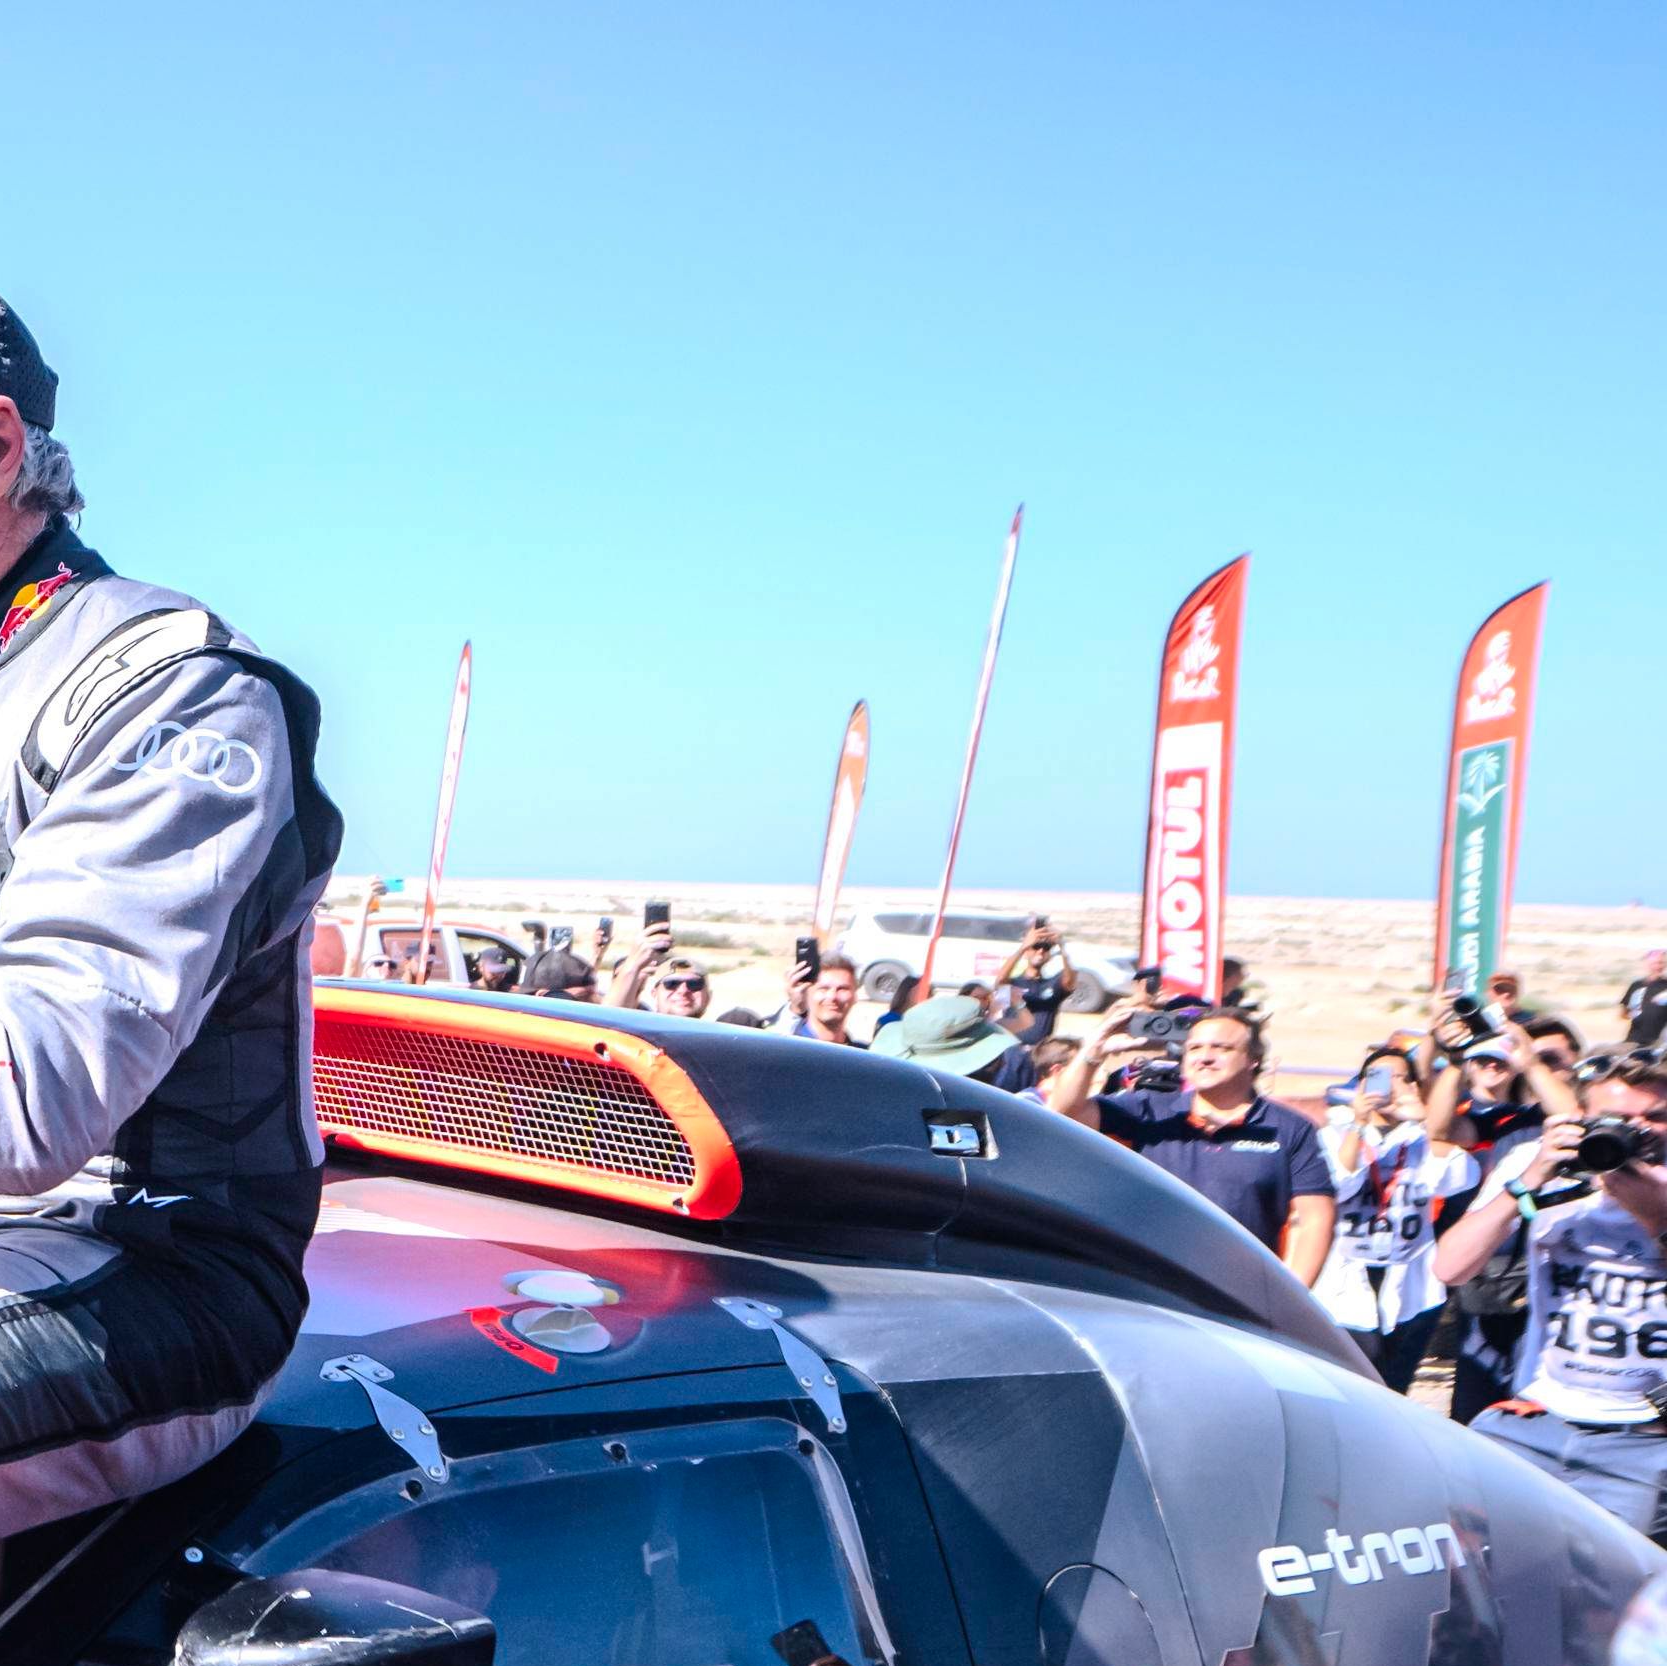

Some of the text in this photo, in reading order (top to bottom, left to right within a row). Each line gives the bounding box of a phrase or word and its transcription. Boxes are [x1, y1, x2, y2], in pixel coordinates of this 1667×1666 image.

[1160, 776, 1203, 986] MOTUL
[1457, 931, 1481, 994] AUDI
[1257, 1522, 1464, 1597] e-tron
